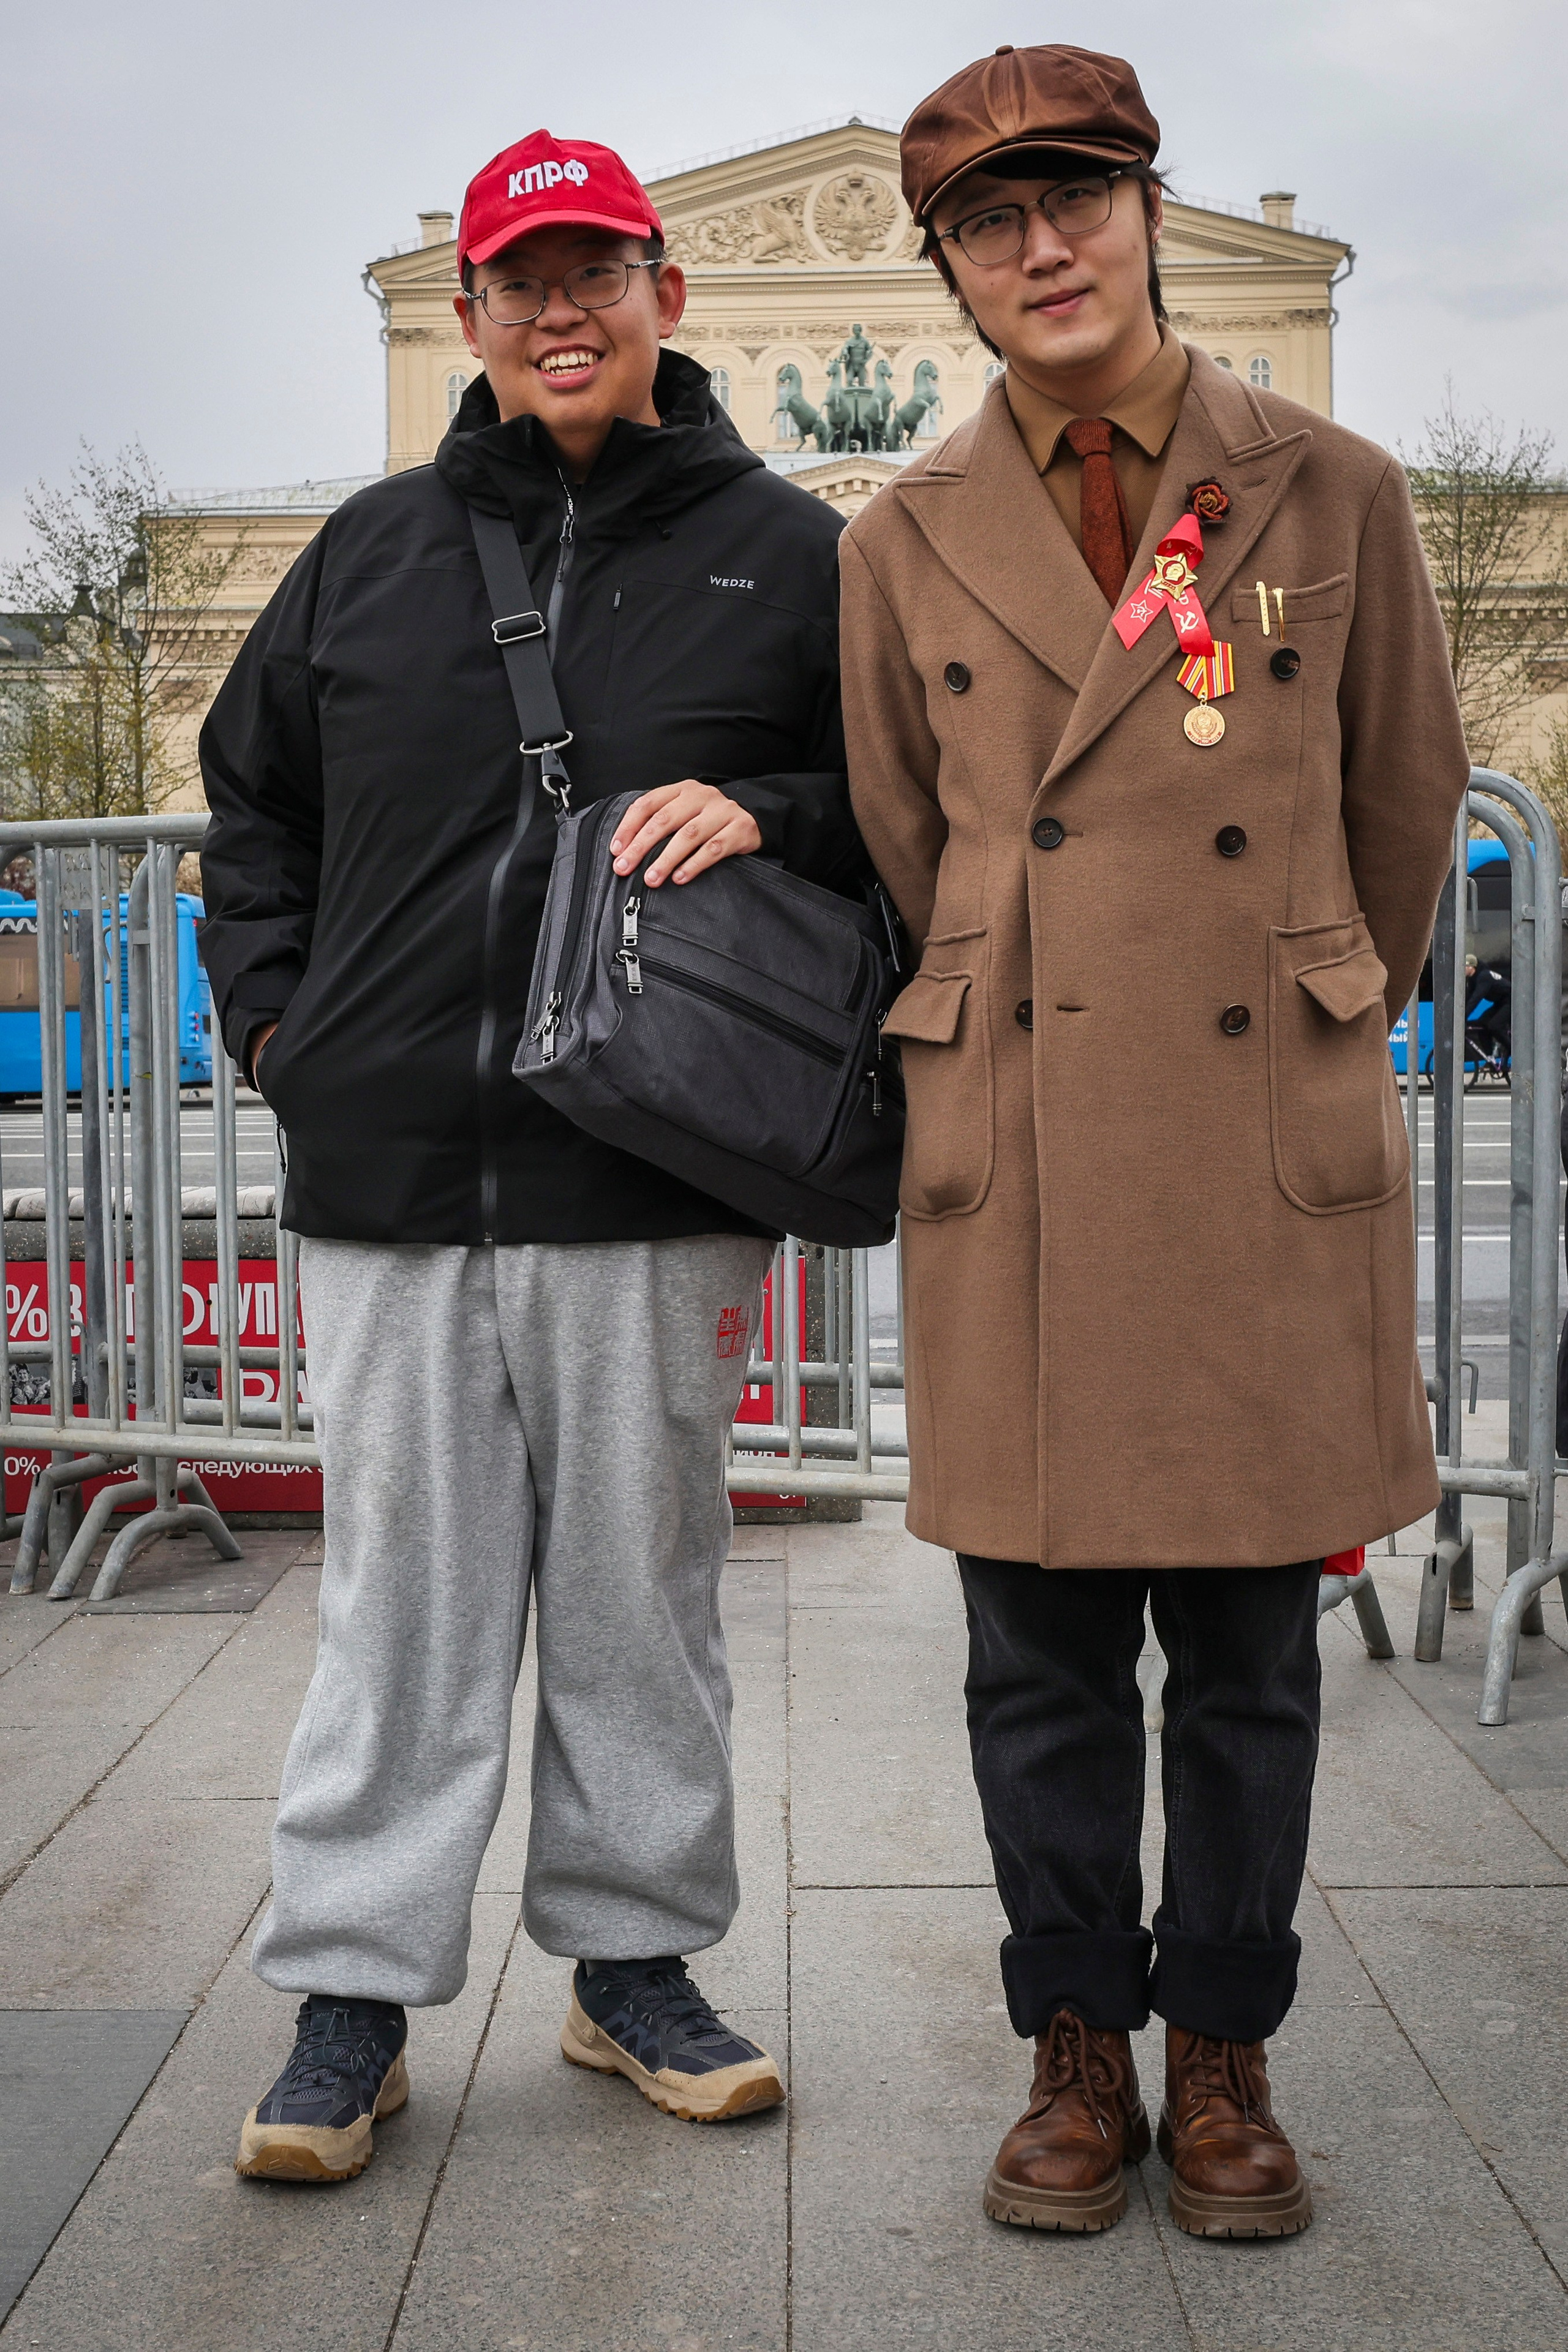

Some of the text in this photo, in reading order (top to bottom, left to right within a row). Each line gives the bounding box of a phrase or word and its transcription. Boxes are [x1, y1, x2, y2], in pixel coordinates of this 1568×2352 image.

[508, 159, 589, 198] КПРФ
[709, 575, 755, 589] WEDZE
[177, 1461, 313, 1479] следующих
